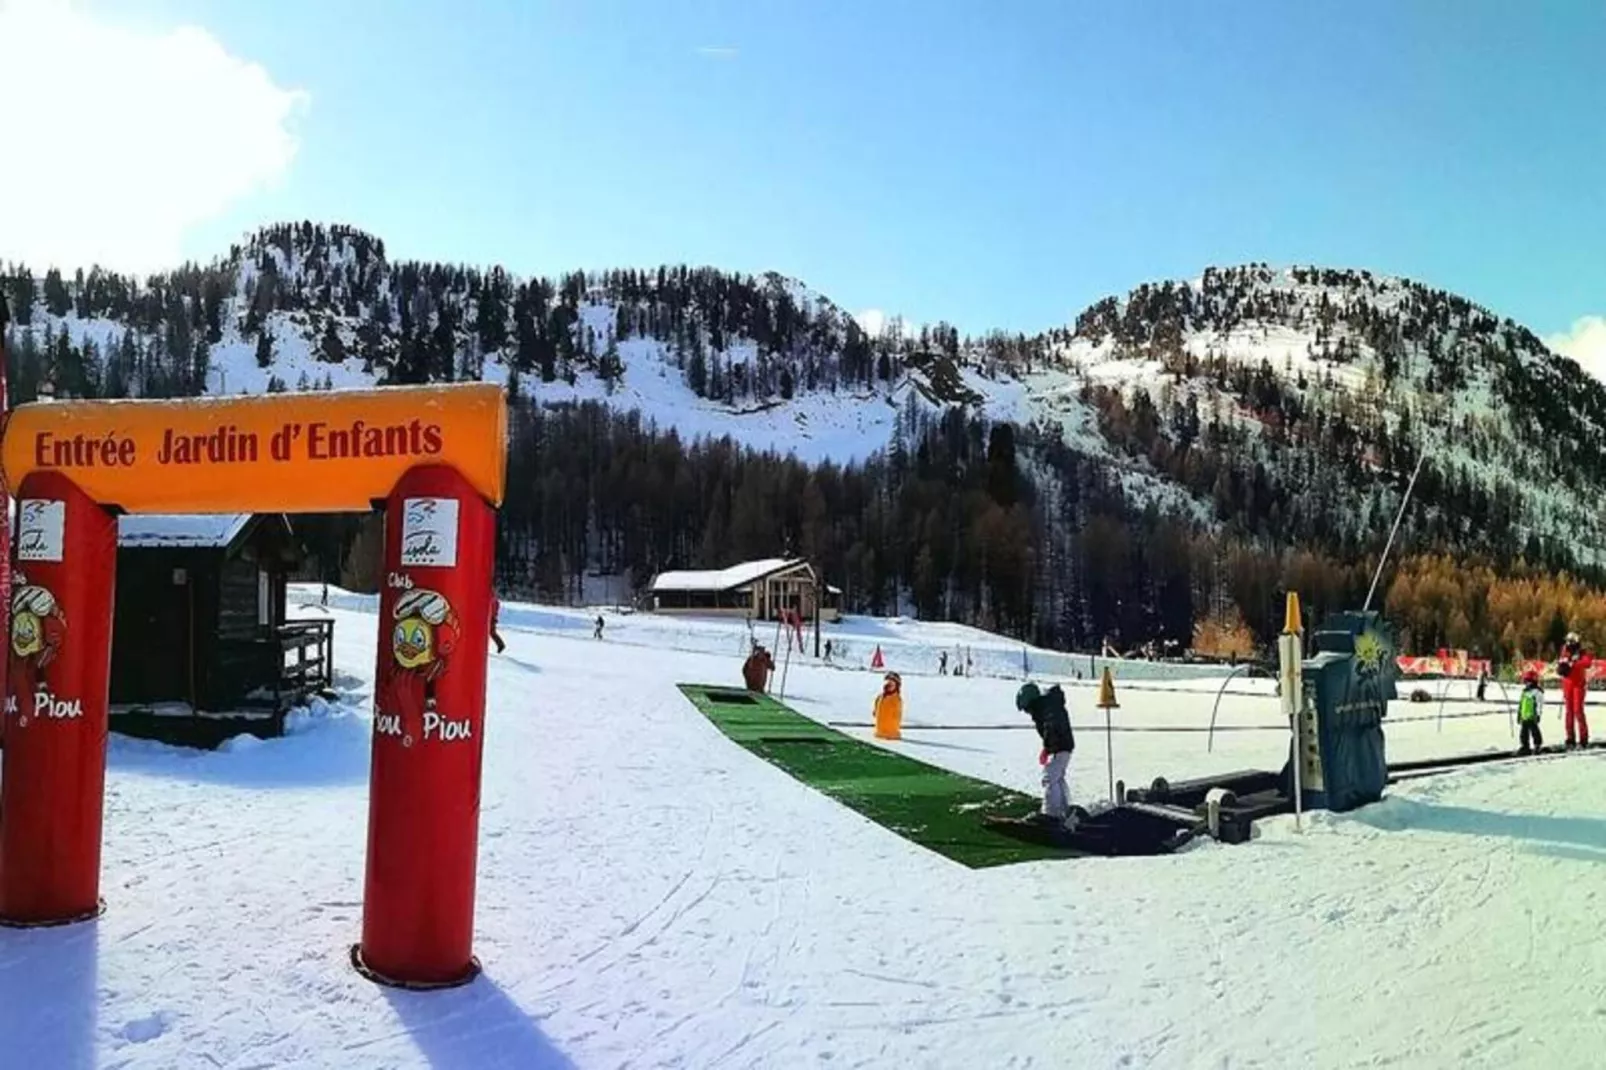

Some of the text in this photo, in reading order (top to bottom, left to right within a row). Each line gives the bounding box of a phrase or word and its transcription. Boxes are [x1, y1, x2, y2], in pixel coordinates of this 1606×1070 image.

[35, 431, 136, 467] Entrée
[157, 425, 258, 465] Jardin
[34, 692, 83, 718] Piou
[422, 711, 472, 740] Piou
